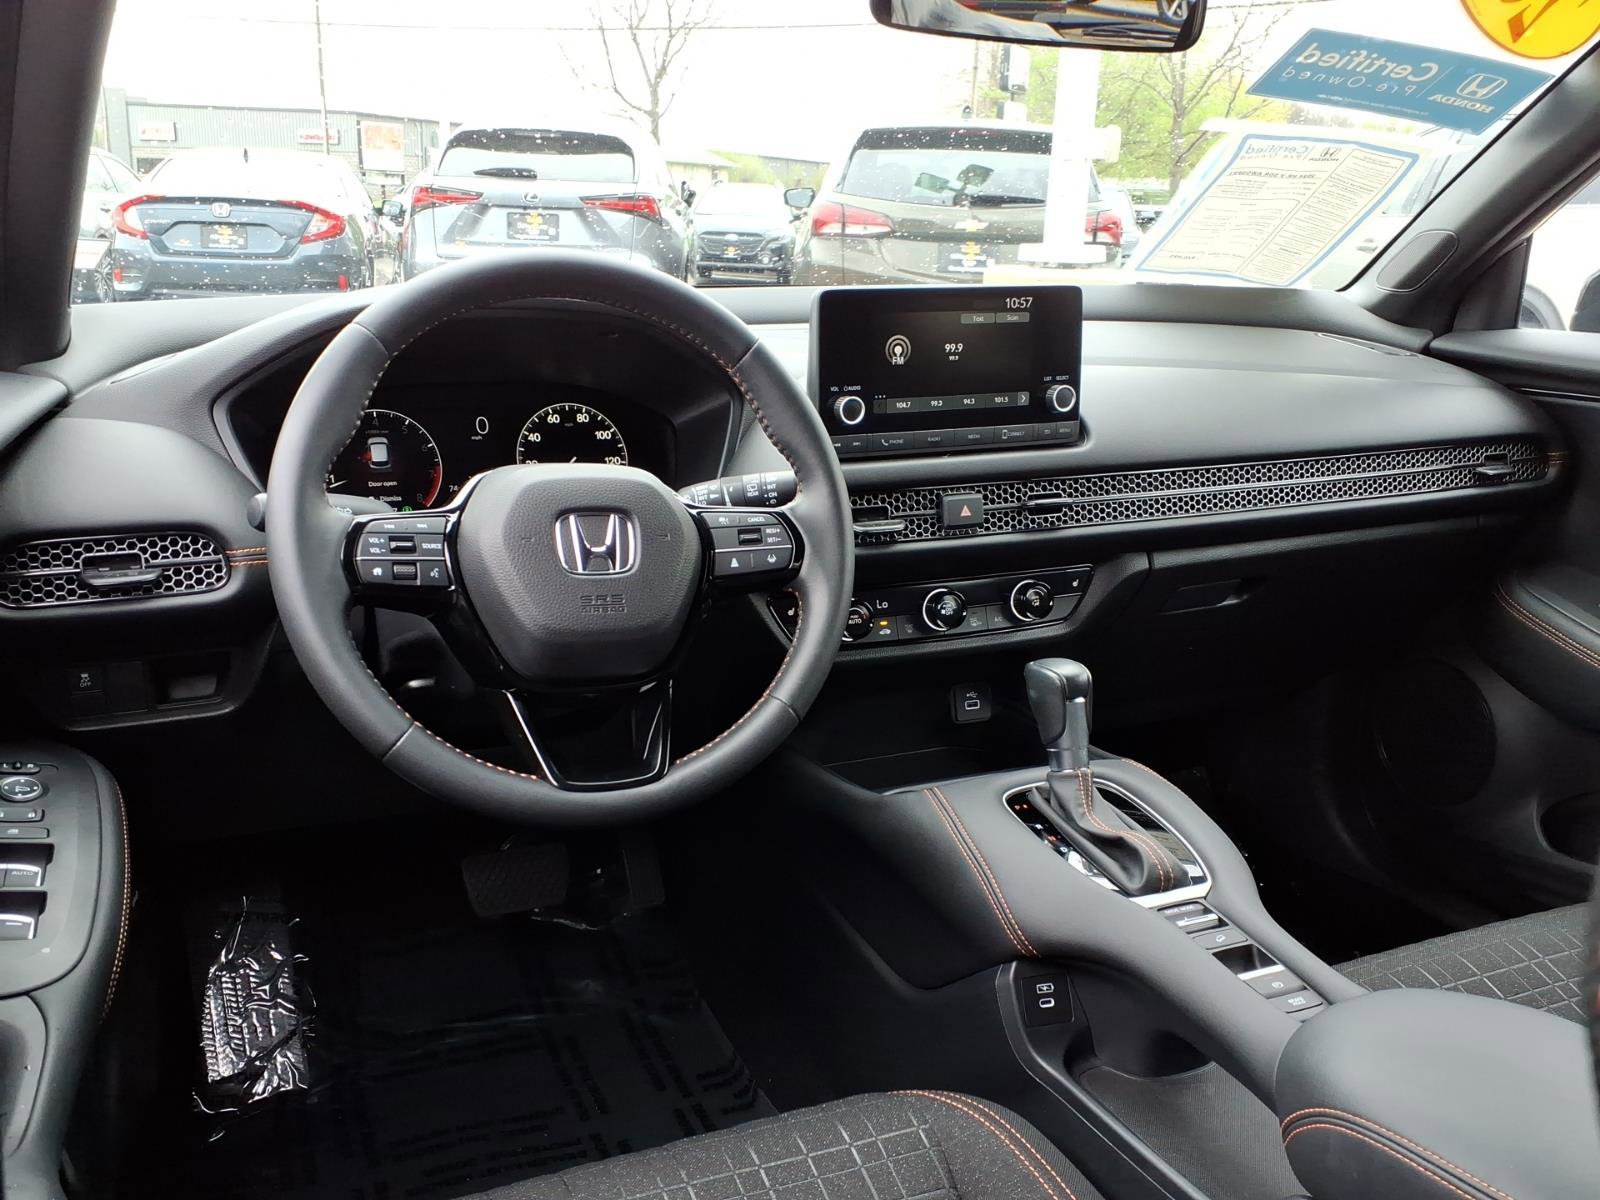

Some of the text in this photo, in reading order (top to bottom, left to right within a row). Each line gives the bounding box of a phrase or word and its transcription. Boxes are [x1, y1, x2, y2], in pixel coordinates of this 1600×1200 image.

[1005, 297, 1033, 309] 10:57
[944, 343, 964, 353] 99.9
[892, 356, 905, 366] FM
[547, 414, 560, 423] 60
[576, 413, 589, 423] 80
[475, 416, 489, 434] 0
[527, 433, 541, 442] 40
[594, 430, 612, 440] 100
[604, 456, 621, 465] 120
[876, 600, 889, 609] Lo
